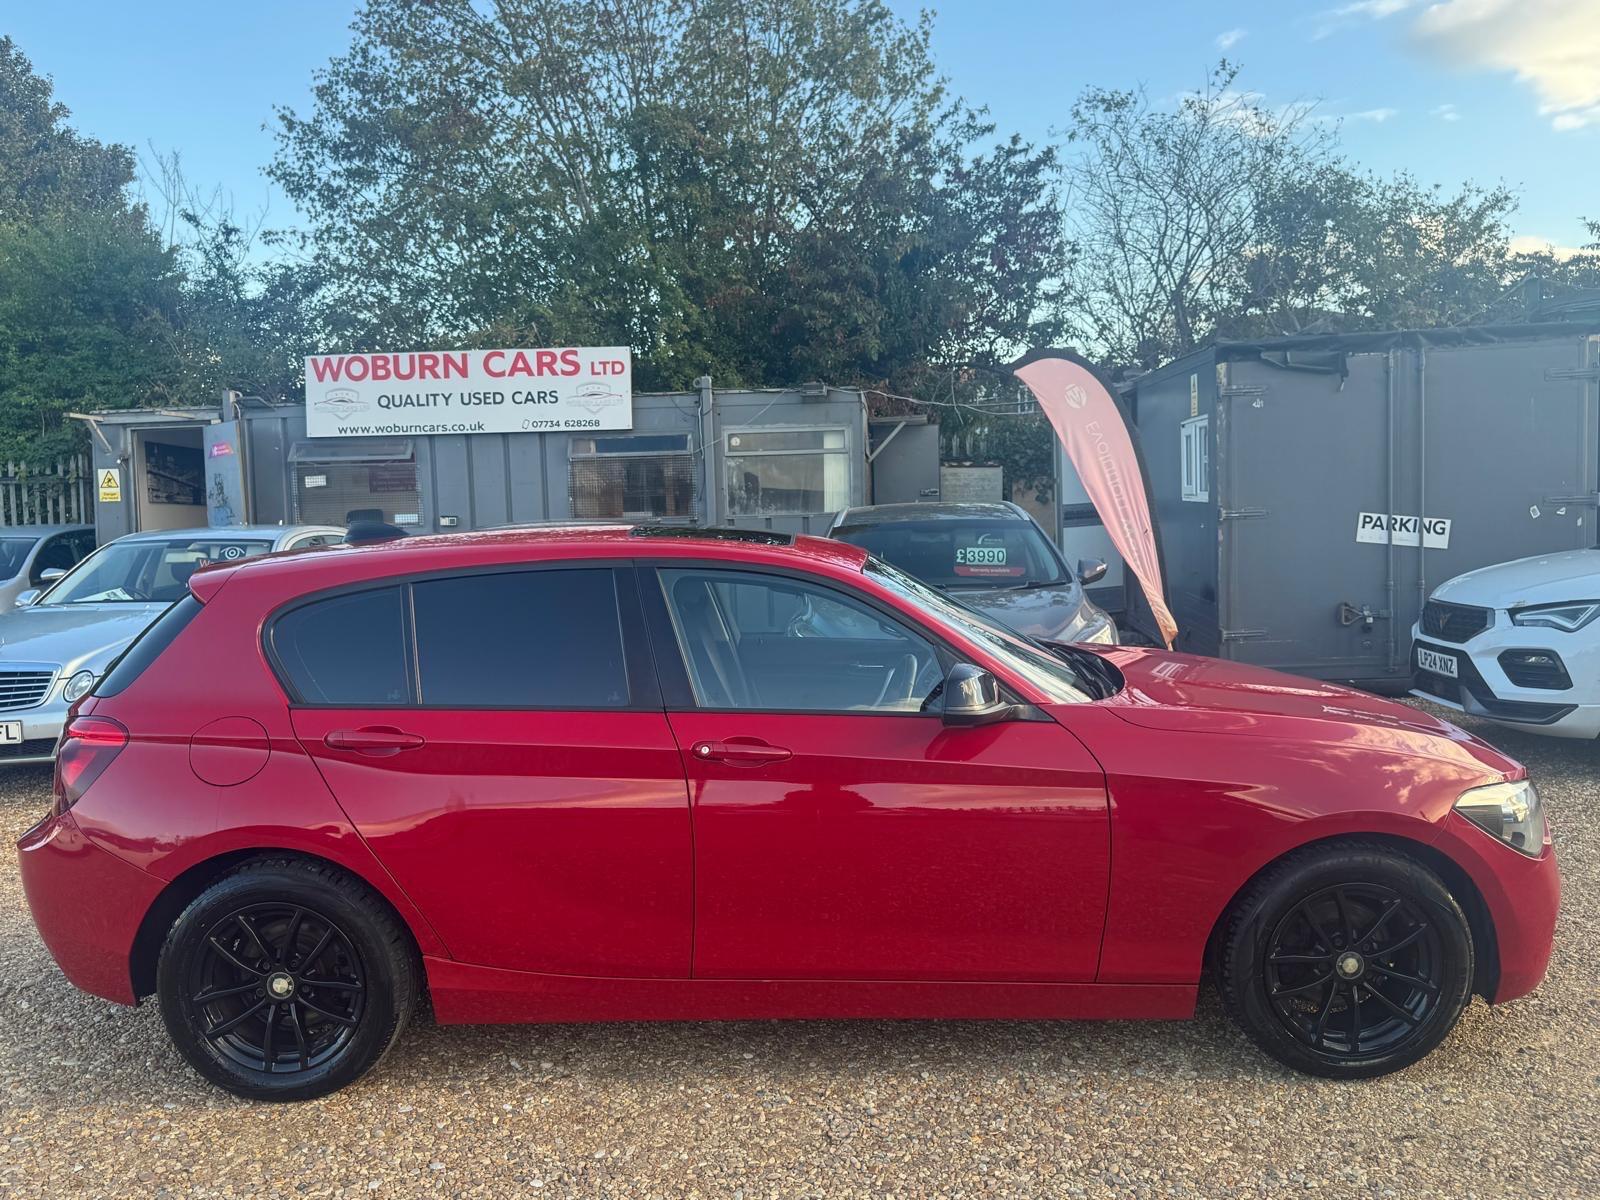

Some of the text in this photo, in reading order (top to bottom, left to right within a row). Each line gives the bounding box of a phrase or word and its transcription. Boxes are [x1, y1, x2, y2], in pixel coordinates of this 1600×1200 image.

[311, 350, 625, 383] WOBURN CARS LTD
[377, 393, 453, 409] QUALITY
[460, 391, 505, 406] USED
[511, 390, 559, 405] CARS
[338, 419, 600, 435] www.woburncars.co.uk 07734 628268
[1361, 514, 1447, 536] PARKING
[956, 548, 1006, 563] £3990
[1438, 655, 1455, 674] XNZ
[0, 724, 18, 741] L
